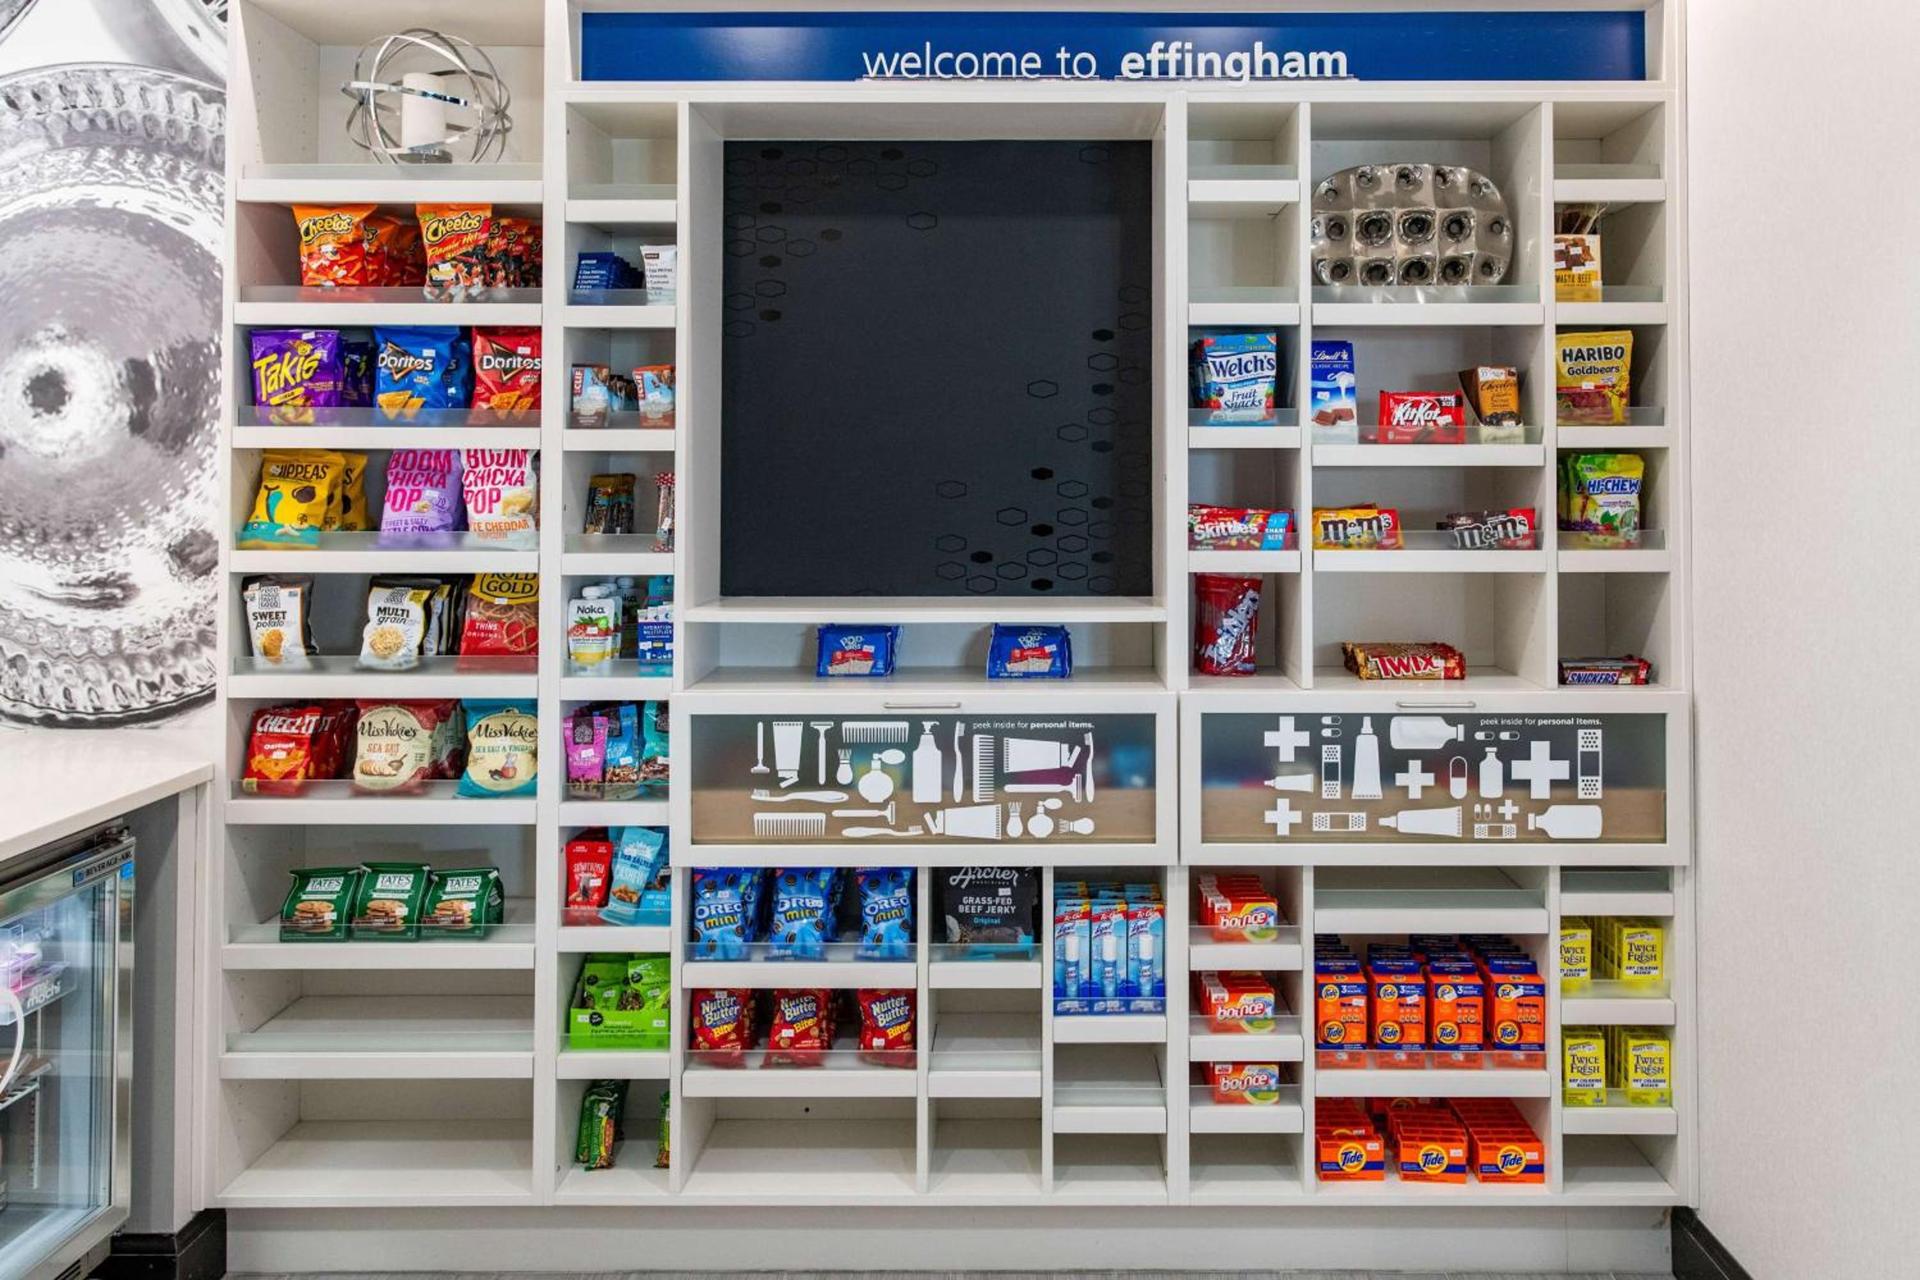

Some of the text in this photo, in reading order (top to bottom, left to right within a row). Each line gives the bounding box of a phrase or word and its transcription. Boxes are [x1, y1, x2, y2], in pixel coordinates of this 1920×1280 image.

[863, 41, 1348, 87] welcome to effingham
[300, 214, 352, 241] Cheetos
[426, 213, 481, 243] Cheetos
[378, 352, 434, 370] Doritos
[482, 354, 542, 370] Doritos
[1562, 346, 1625, 363] HARIBO
[1210, 355, 1276, 377] Welch's
[1567, 364, 1620, 376] Goldbears
[253, 351, 321, 401] Takis
[1231, 388, 1258, 401] Fruit
[1224, 399, 1263, 412] Snacks
[1391, 401, 1441, 426] KitKat
[388, 449, 452, 474] BOOM
[388, 470, 447, 489] HICKA
[463, 468, 525, 487] CHICKA
[1587, 477, 1641, 494] HI-CHEW
[463, 487, 502, 514] POP
[1194, 520, 1259, 540] Skittles
[486, 580, 533, 594] GOLD
[252, 610, 287, 621] SWEET
[376, 606, 410, 618] MULTI
[576, 605, 606, 614] Noka
[256, 619, 285, 630] potato
[377, 616, 408, 625] grain
[475, 622, 498, 630] THINS
[1370, 655, 1442, 678] TWIX
[1569, 672, 1618, 684] SNICKERS
[359, 721, 384, 738] Miss
[383, 718, 418, 741] Vickie's
[476, 722, 501, 738] Miss
[973, 721, 991, 729] peek
[993, 721, 1016, 729] inside
[1030, 721, 1067, 730] personal
[1069, 721, 1095, 729] items.
[1480, 718, 1498, 726] peek
[1538, 718, 1574, 726] personal
[366, 743, 382, 753] SEA
[311, 878, 342, 888] TATE'S
[380, 876, 413, 886] TATE'S
[449, 878, 481, 888] TATE'S
[950, 867, 1019, 888] Archer
[865, 896, 909, 916] OREO
[962, 896, 1013, 905] GRASS-FED
[695, 903, 743, 919] OREO
[785, 908, 818, 922] mini
[874, 908, 904, 924] mini
[958, 905, 1016, 914] BEEF JERKY
[705, 914, 738, 930] mini
[973, 916, 1001, 925] Original
[1219, 911, 1268, 929] bounce
[1629, 943, 1657, 952] TWICE
[1627, 952, 1658, 964] FRESH
[701, 996, 737, 1014] Nutter
[785, 1003, 817, 1021] Butter
[871, 996, 907, 1016] Nutter
[1216, 1001, 1265, 1019] bounce
[705, 1006, 740, 1025] Butter
[877, 1005, 911, 1027] Butter
[1326, 1027, 1343, 1037] Tide
[1381, 1027, 1398, 1037] Tide
[1440, 1027, 1457, 1037] Tide
[1500, 1027, 1517, 1037] Tide
[1571, 1054, 1600, 1064] TWICE
[1634, 1054, 1665, 1064] TWICE
[1570, 1064, 1600, 1075] FRESH
[1634, 1064, 1665, 1076] FRESH
[1220, 1073, 1269, 1091] bounce
[1341, 1151, 1364, 1167] Tide
[1422, 1152, 1445, 1168] Tide
[1500, 1153, 1523, 1169] Tide
